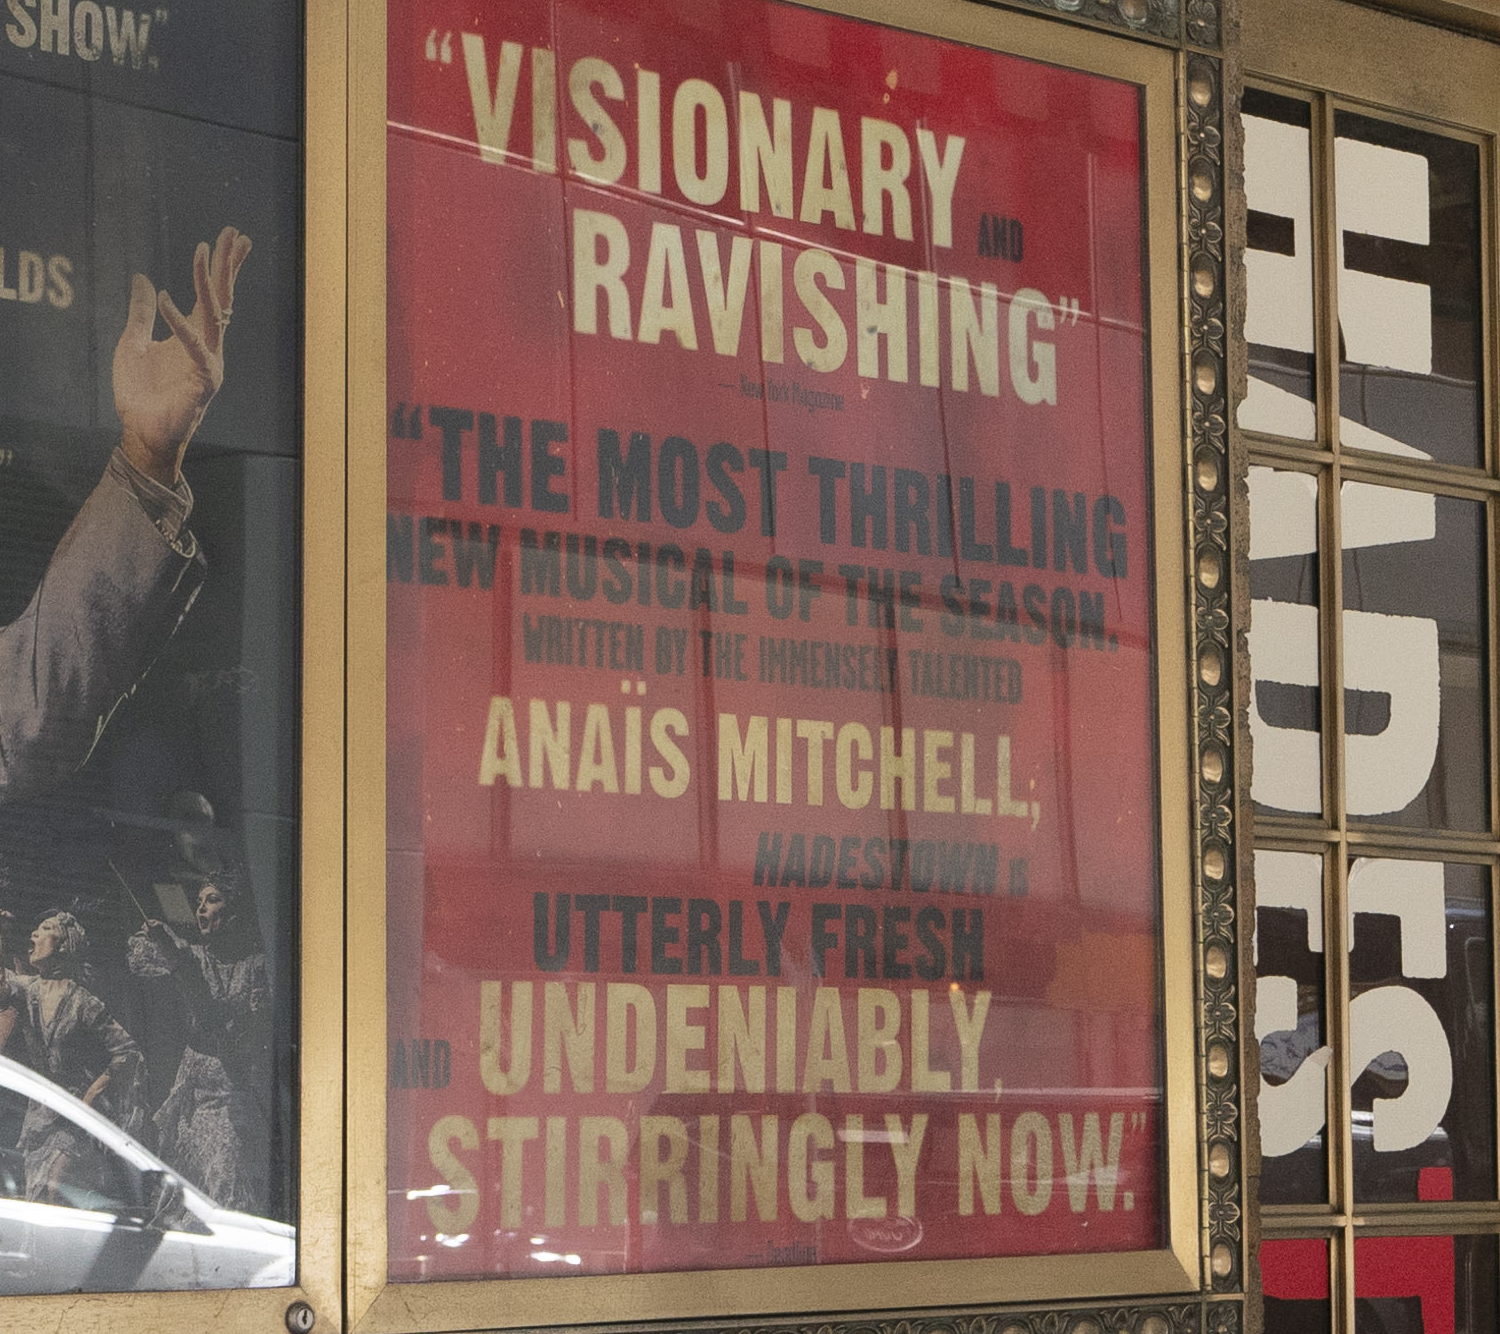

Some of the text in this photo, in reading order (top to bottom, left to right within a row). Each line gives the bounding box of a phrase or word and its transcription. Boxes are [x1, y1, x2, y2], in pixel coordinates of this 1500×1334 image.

[426, 28, 1025, 263] “VISIONARY AND
[572, 207, 1080, 407] RAVISHING”
[597, 427, 789, 538] MOST
[808, 455, 1128, 579] THRILLING
[386, 514, 1120, 654] NEW MUSICAL OF THE SEASON.
[523, 612, 1024, 706] WRITTEN BY THE IMMENSELY TALENTED
[478, 679, 1041, 830] ANAÏS MITCHELL,
[752, 830, 1000, 896] HADESTOWN
[532, 890, 986, 983] UTTERLY FRESH
[388, 979, 1003, 1101] AND UNDENIABLY,
[426, 1112, 929, 1236] STIRRINGLY
